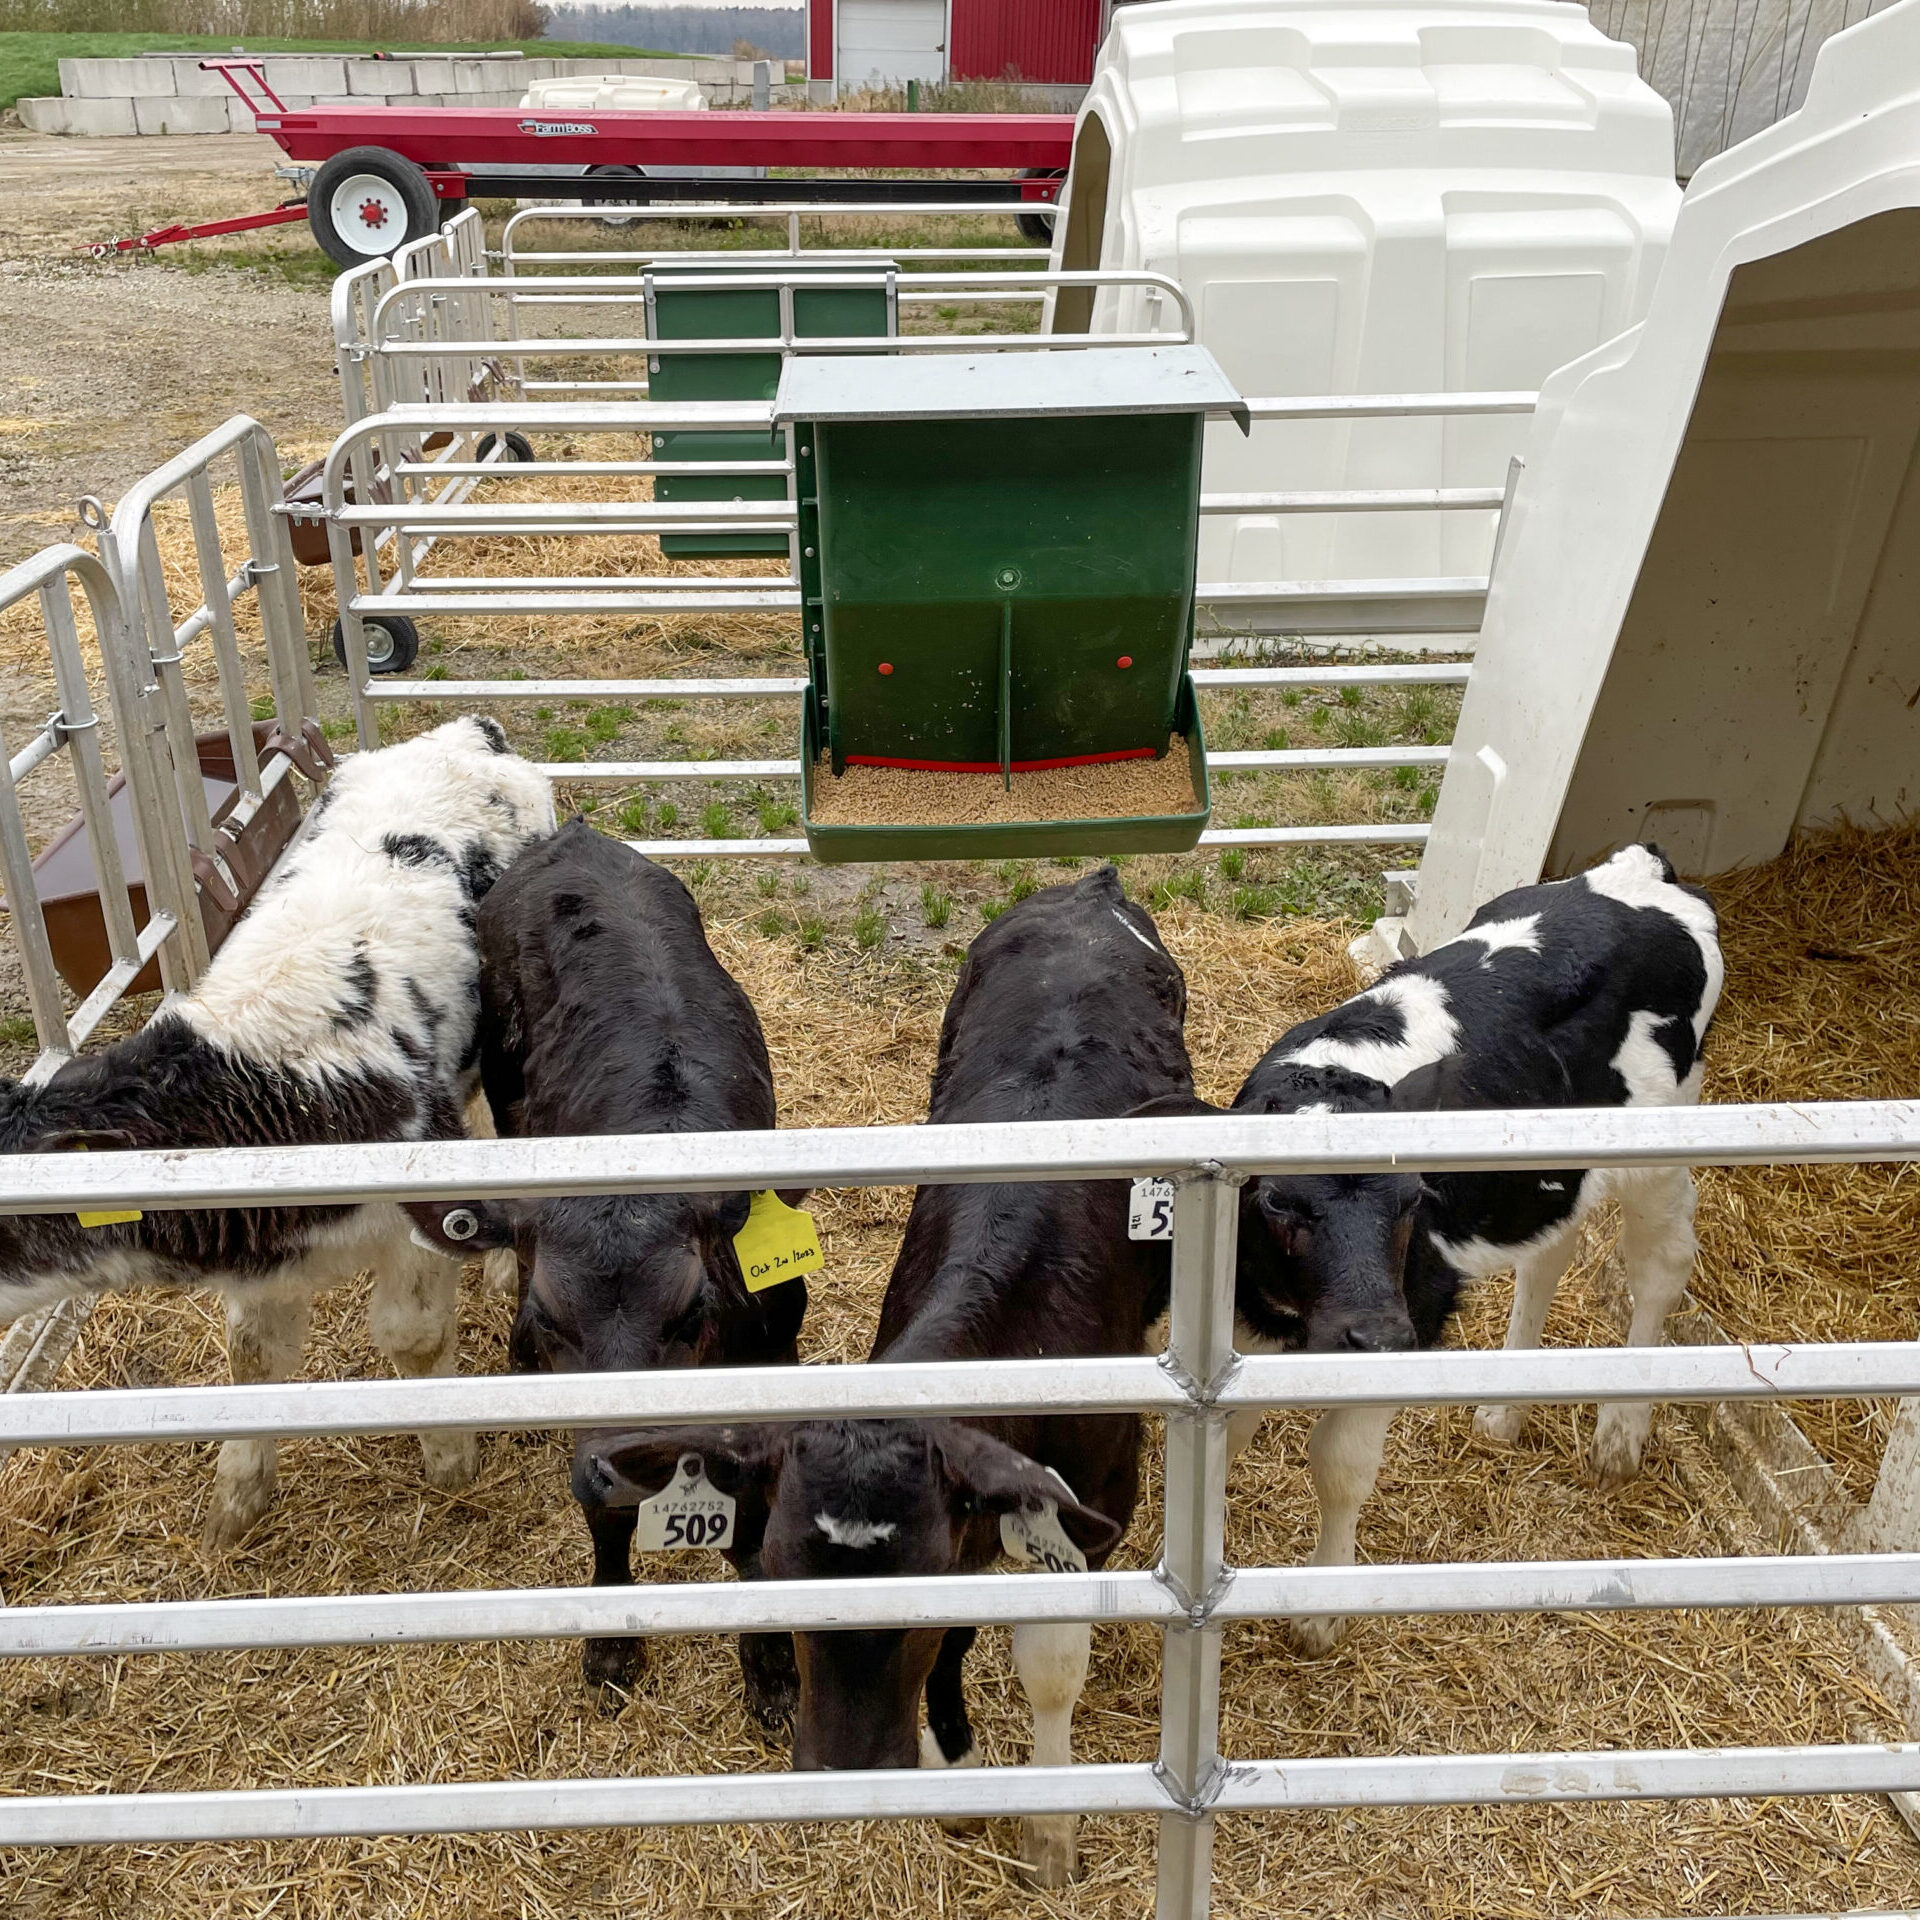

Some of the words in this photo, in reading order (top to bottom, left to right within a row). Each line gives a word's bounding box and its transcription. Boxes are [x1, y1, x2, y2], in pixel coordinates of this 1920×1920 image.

[1151, 1200, 1173, 1236] 5
[750, 1263, 770, 1277] Oct
[663, 1513, 728, 1547] 509
